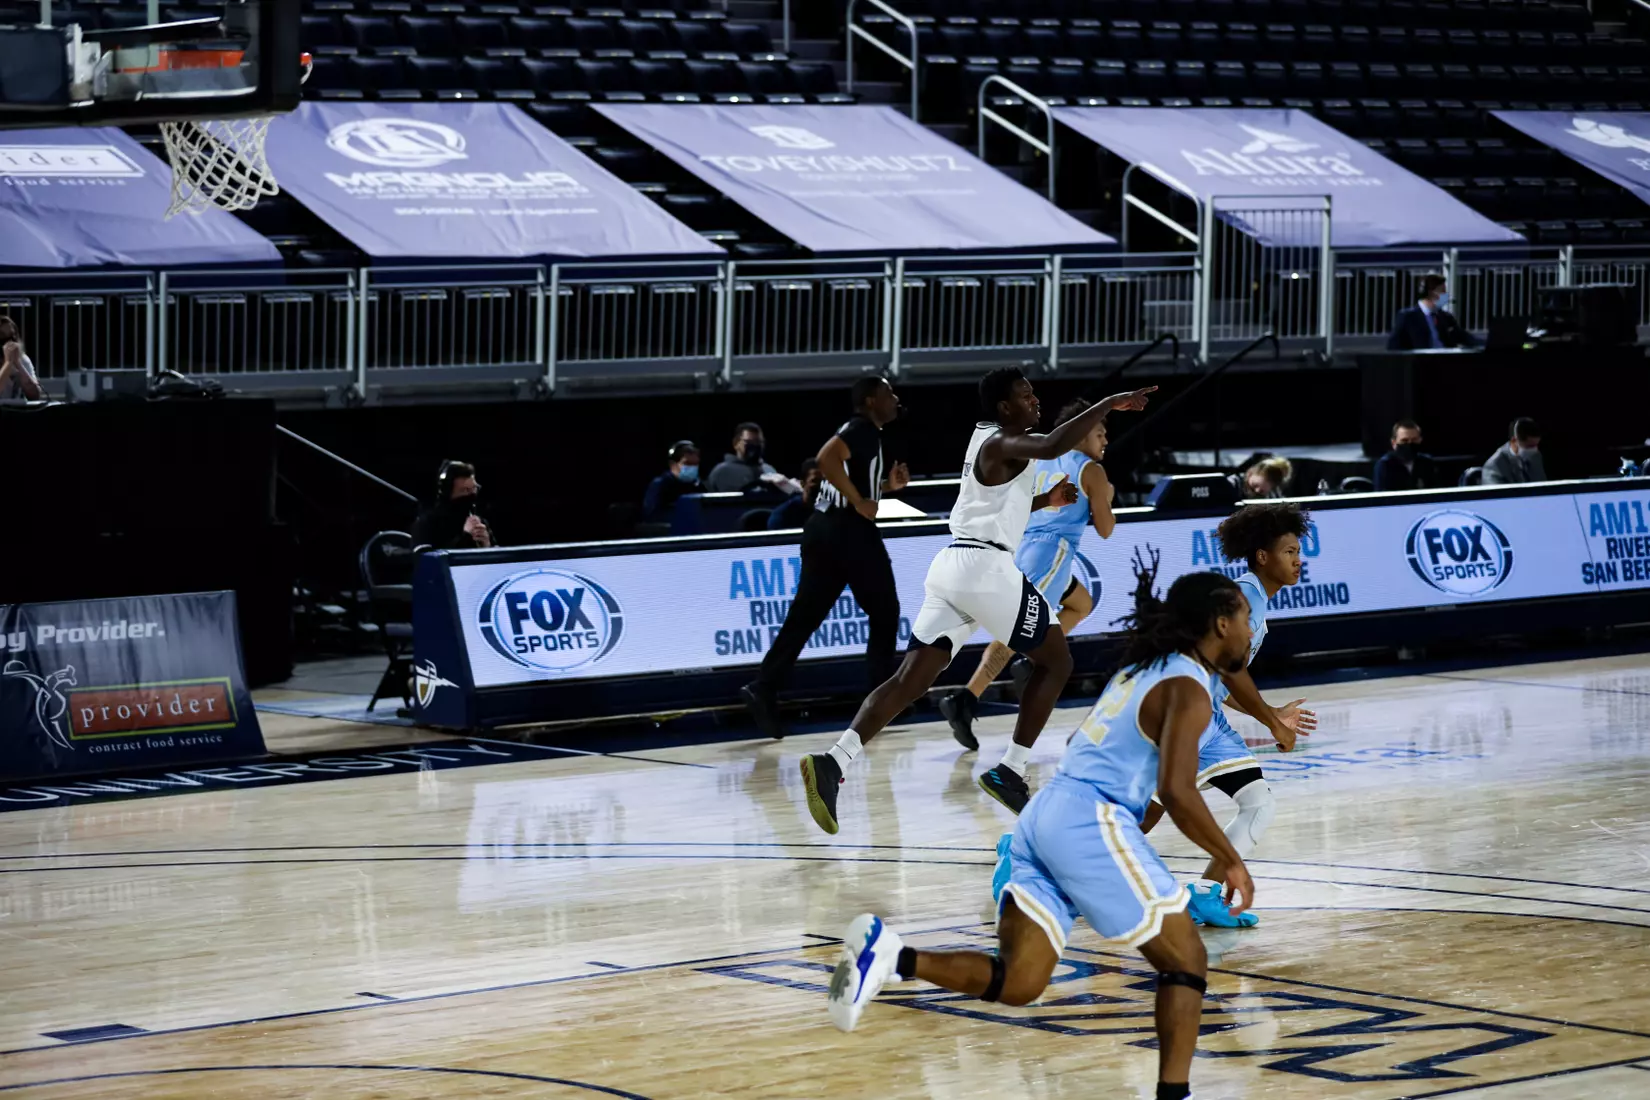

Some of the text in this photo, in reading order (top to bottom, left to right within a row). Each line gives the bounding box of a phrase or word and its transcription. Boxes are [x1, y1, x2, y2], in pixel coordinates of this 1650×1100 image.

[1181, 148, 1365, 176] Altura
[1590, 500, 1650, 537] AM1
[1423, 524, 1492, 565] FOX
[1433, 562, 1497, 581] SPORTS
[1581, 561, 1618, 585] SAN
[1266, 582, 1351, 611] NARDINO
[504, 587, 595, 636] FOX
[1020, 593, 1039, 638] LANCERS
[37, 620, 165, 647] Provider.
[513, 630, 600, 654] SPORTS
[715, 627, 762, 656] SAN
[80, 692, 216, 728] provider
[88, 733, 223, 754] contract food service
